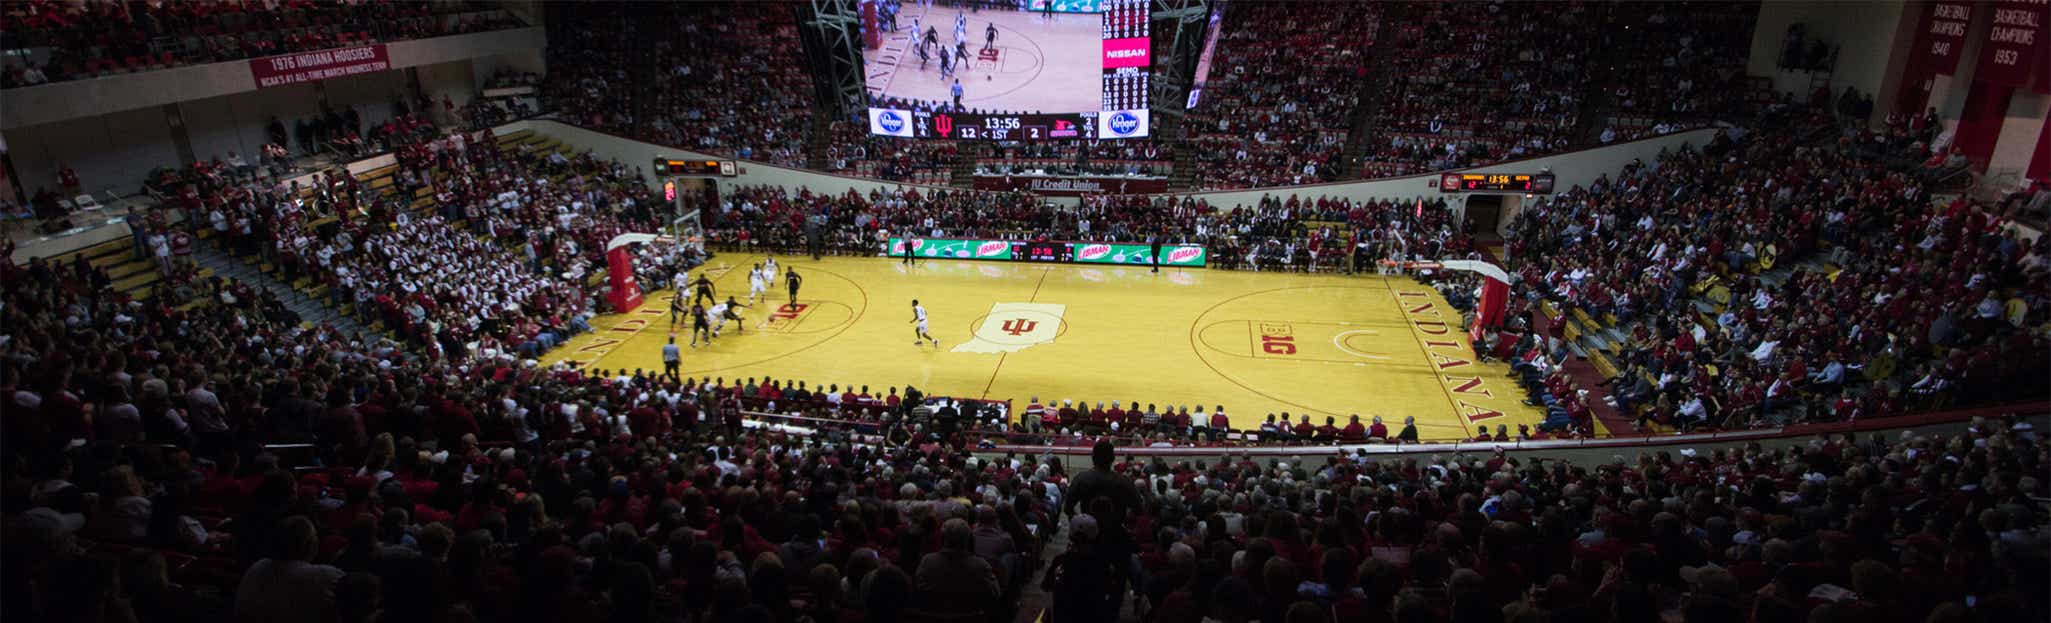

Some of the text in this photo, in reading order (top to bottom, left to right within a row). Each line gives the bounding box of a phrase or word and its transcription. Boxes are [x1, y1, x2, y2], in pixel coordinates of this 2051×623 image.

[1993, 8, 2040, 27] BASKETBALL
[1990, 26, 2036, 45] CHAMPIONS
[271, 47, 376, 71] 1976 INDIANA HOOSIERS
[1106, 49, 1146, 58] NISSAN
[1993, 49, 2019, 65] 1953
[295, 69, 323, 82] ALL-TIME
[880, 113, 902, 131] Kroger
[985, 117, 1020, 130] 13:56
[1112, 114, 1136, 132] Kroger
[961, 128, 975, 138] 12
[992, 130, 1008, 139] 1ST
[1031, 129, 1038, 138] 2
[1032, 179, 1100, 190] IU Credit Union
[1489, 175, 1509, 184] 13:56
[976, 241, 1006, 257] LIBMAN
[1078, 246, 1109, 261] LIBMAN
[1167, 247, 1200, 263] LIBMAN
[1396, 289, 1504, 424] INDIANA
